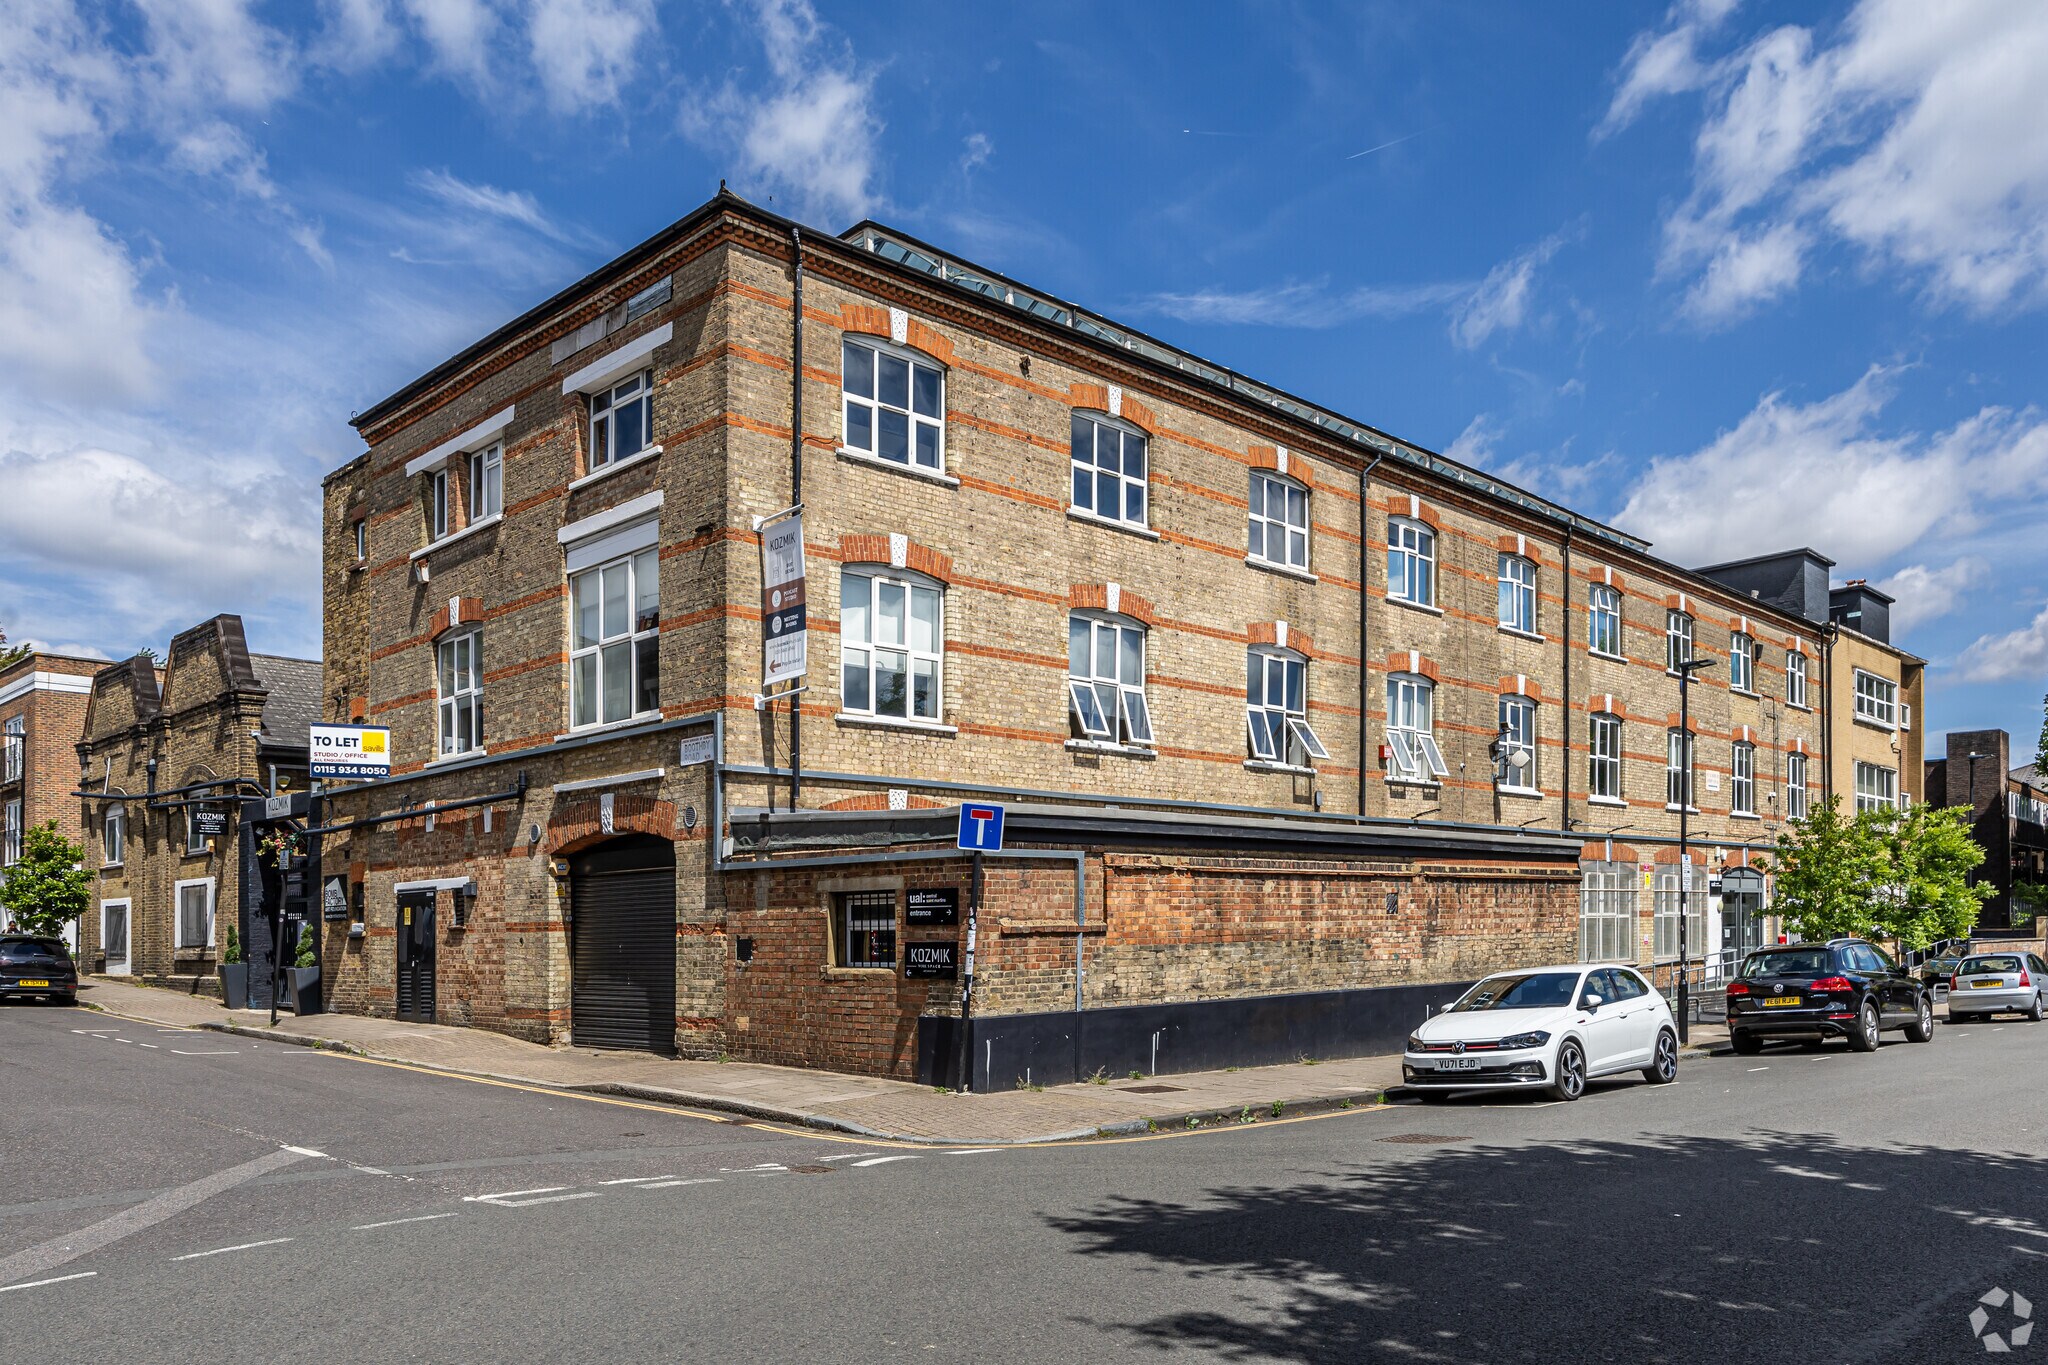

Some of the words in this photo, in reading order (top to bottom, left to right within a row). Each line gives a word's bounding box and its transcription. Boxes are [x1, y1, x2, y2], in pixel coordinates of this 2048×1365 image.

[770, 532, 796, 552] KOZMIK
[314, 736, 332, 746] TO
[336, 737, 359, 747] LET
[684, 740, 710, 753] BOOTHBY
[684, 752, 700, 761] ROAD
[268, 796, 288, 811] KOZMIK
[910, 892, 926, 903] ual:
[911, 948, 950, 962] KOZMIK
[1439, 1060, 1457, 1068] VU71
[1459, 1059, 1476, 1068] EJD
